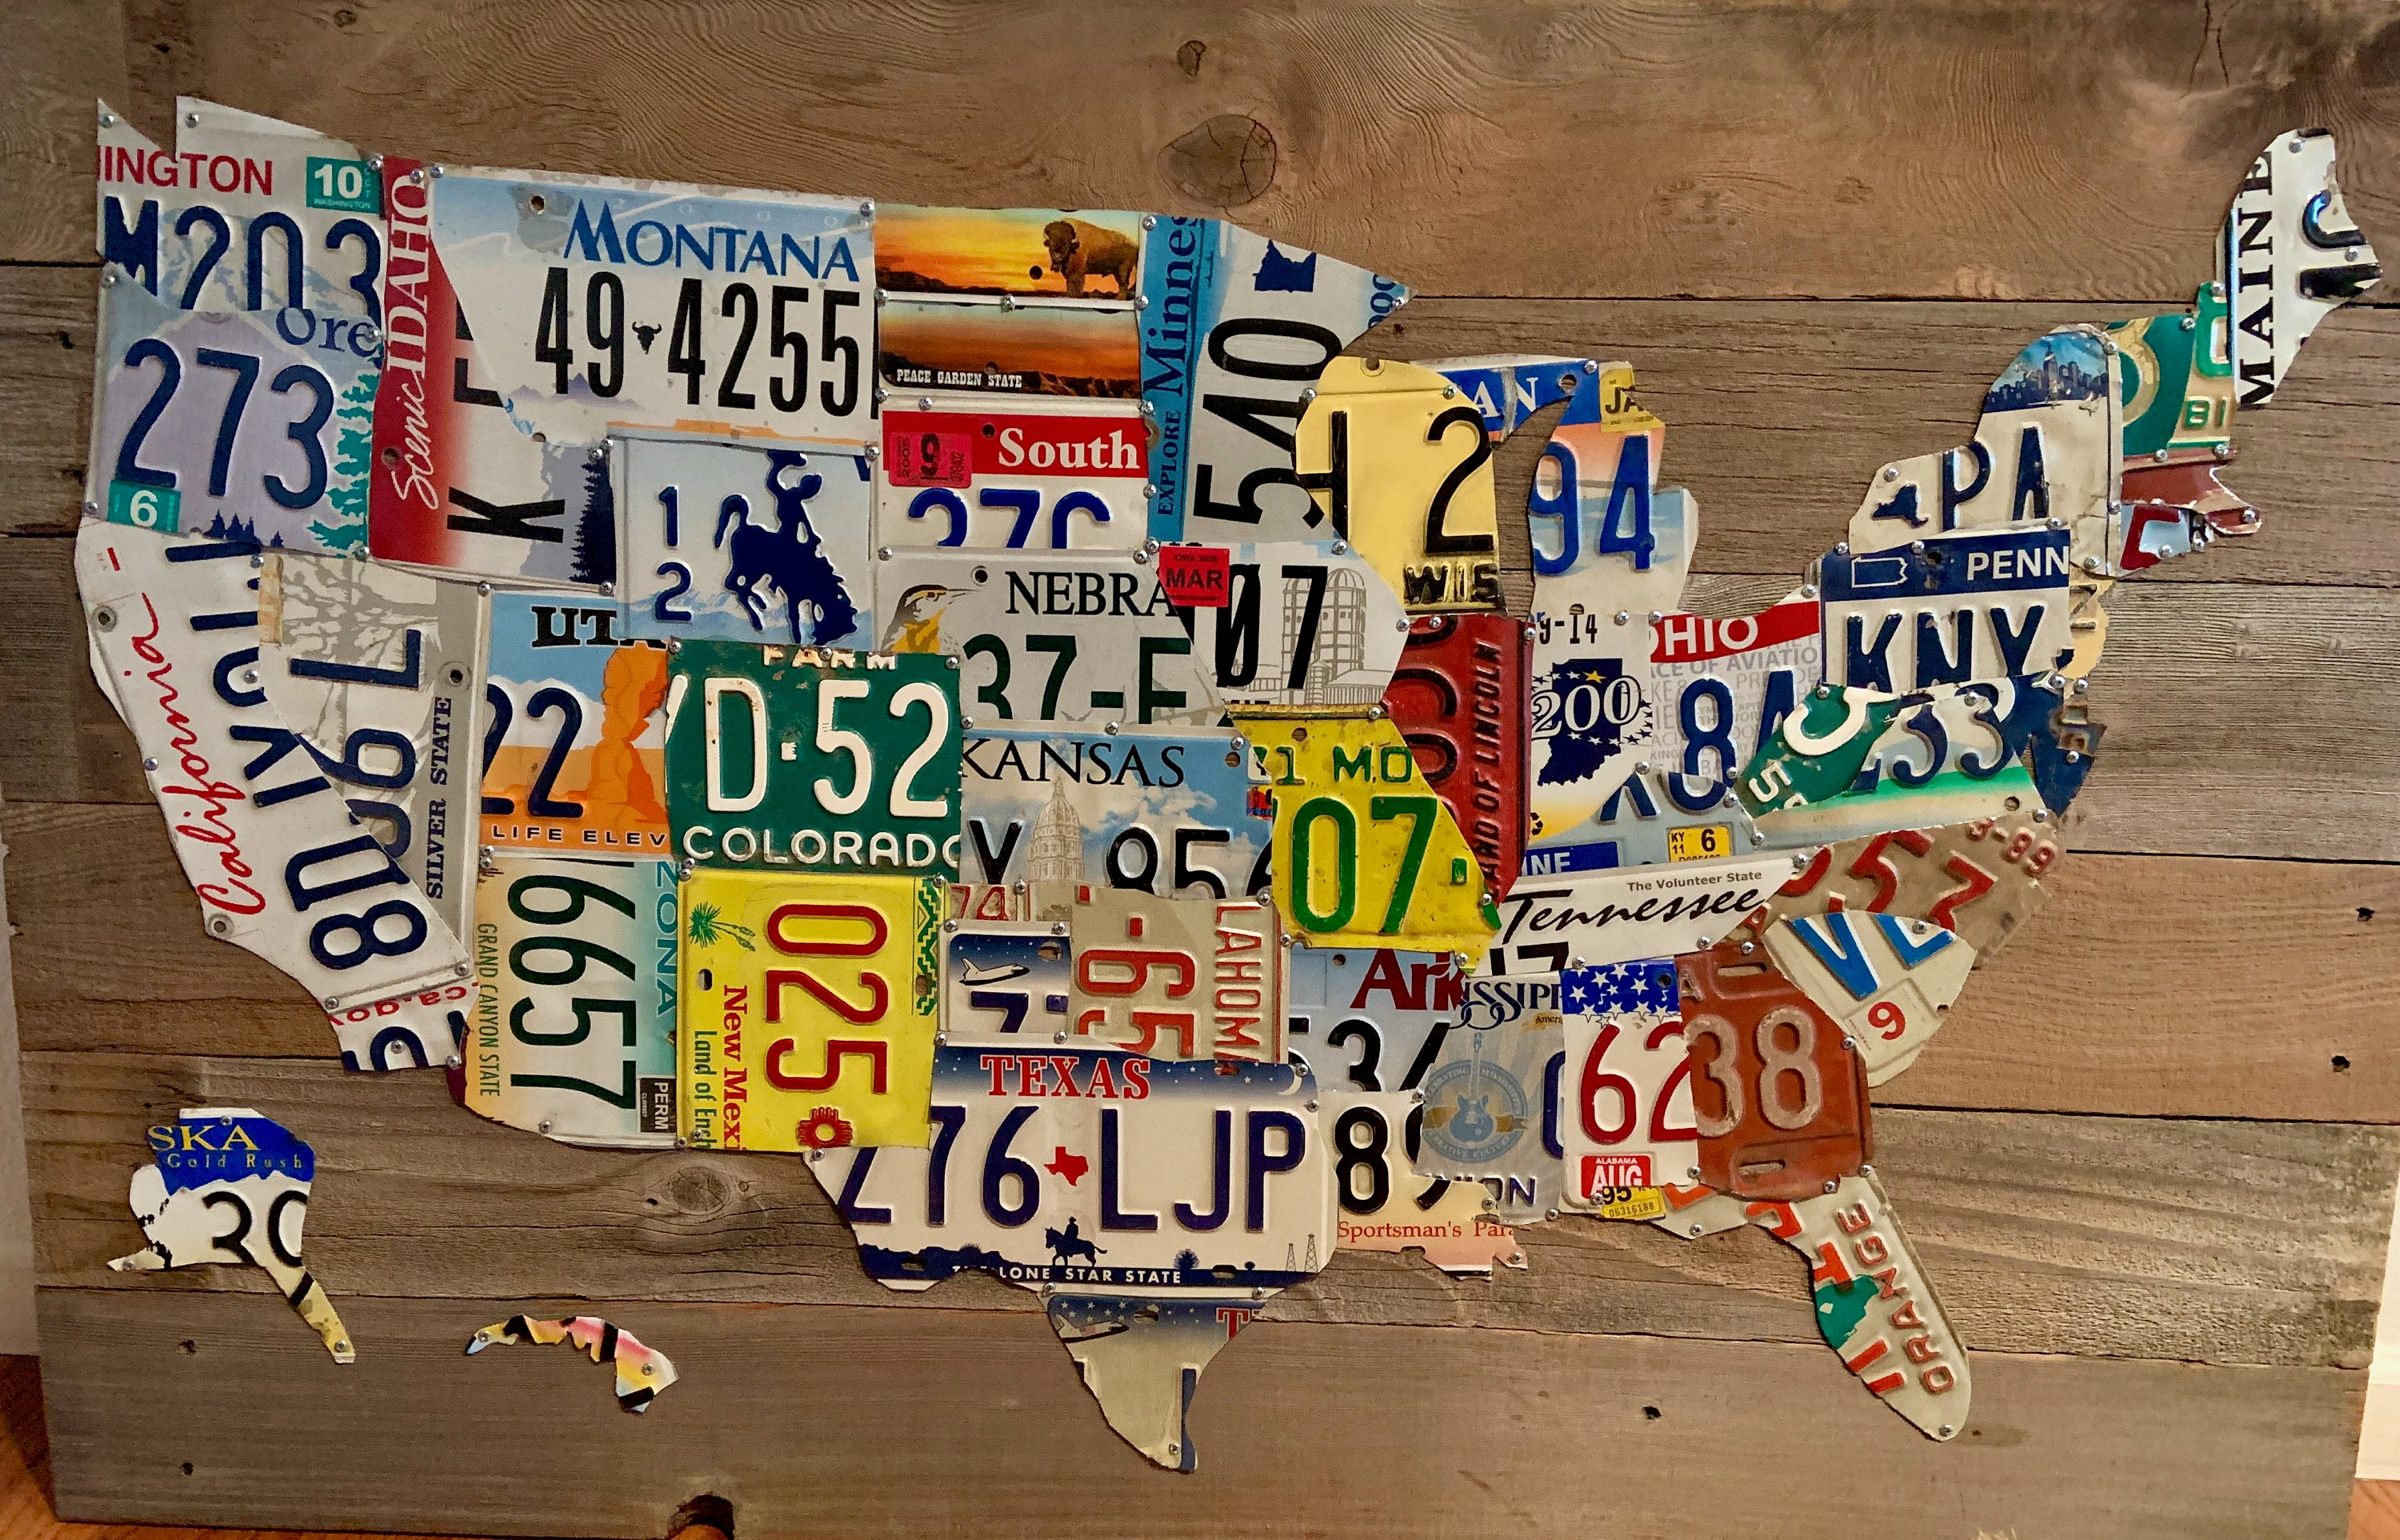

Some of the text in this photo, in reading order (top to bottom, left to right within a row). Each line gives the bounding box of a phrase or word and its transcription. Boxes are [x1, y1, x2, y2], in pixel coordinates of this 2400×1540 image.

[314, 163, 363, 199] 10
[564, 198, 860, 282] MONTANA
[386, 174, 439, 510] Scenic IDAHO
[896, 369, 1022, 388] PEACE GARDEN STATE
[114, 338, 335, 510] 273
[999, 427, 1140, 470] South
[1157, 410, 1182, 517] EXPLORE
[130, 490, 159, 527] 6
[1166, 567, 1224, 590] MAR
[1966, 546, 2070, 582] PENN
[123, 592, 267, 915] California
[961, 737, 1186, 788] KANSAS
[426, 696, 452, 899] SILVER STATE
[493, 824, 666, 846] LIFE ELEV
[1670, 829, 1717, 853] KY 6
[1671, 845, 1686, 854] 11
[1627, 870, 1762, 893] The Volunteer State
[1502, 888, 1766, 946] Tennessee
[477, 922, 501, 1098] GRAND CANYON STATE
[765, 899, 890, 1095] 025
[723, 984, 748, 1062] New
[694, 1030, 718, 1076] Land
[694, 1082, 718, 1102] of
[981, 1054, 1151, 1100] TEXAS
[653, 1082, 670, 1130] PERM
[147, 1124, 261, 1150] SKA
[166, 1152, 303, 1169] Gold Rush
[1100, 1108, 1306, 1233] LJP
[1595, 1157, 1638, 1165] ALABAMA
[1338, 1220, 1462, 1243] Sportsman's
[1065, 1267, 1113, 1282] STAR
[1125, 1270, 1182, 1285] STATE
